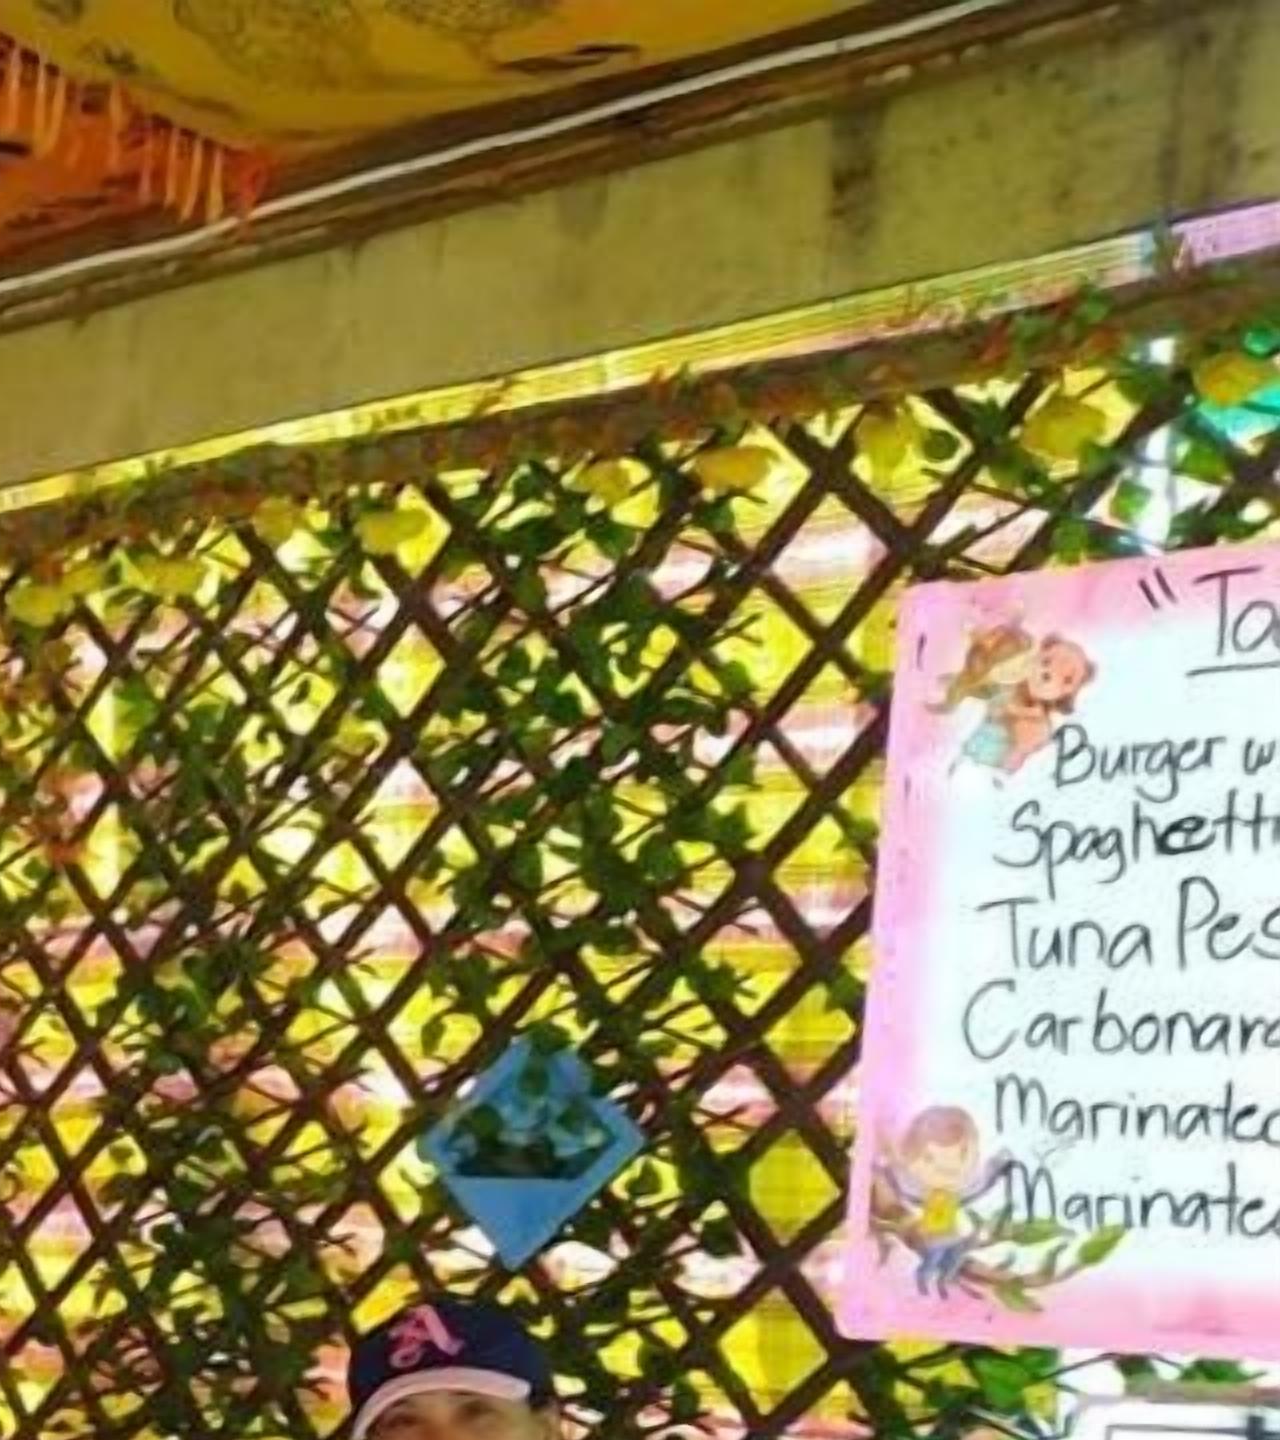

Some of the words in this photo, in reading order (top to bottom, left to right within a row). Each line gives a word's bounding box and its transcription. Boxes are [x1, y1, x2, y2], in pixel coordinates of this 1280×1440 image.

[1051, 722, 1227, 804] Burger
[974, 896, 1154, 971] Tuna
[1003, 1158, 1280, 1239] Marinate
